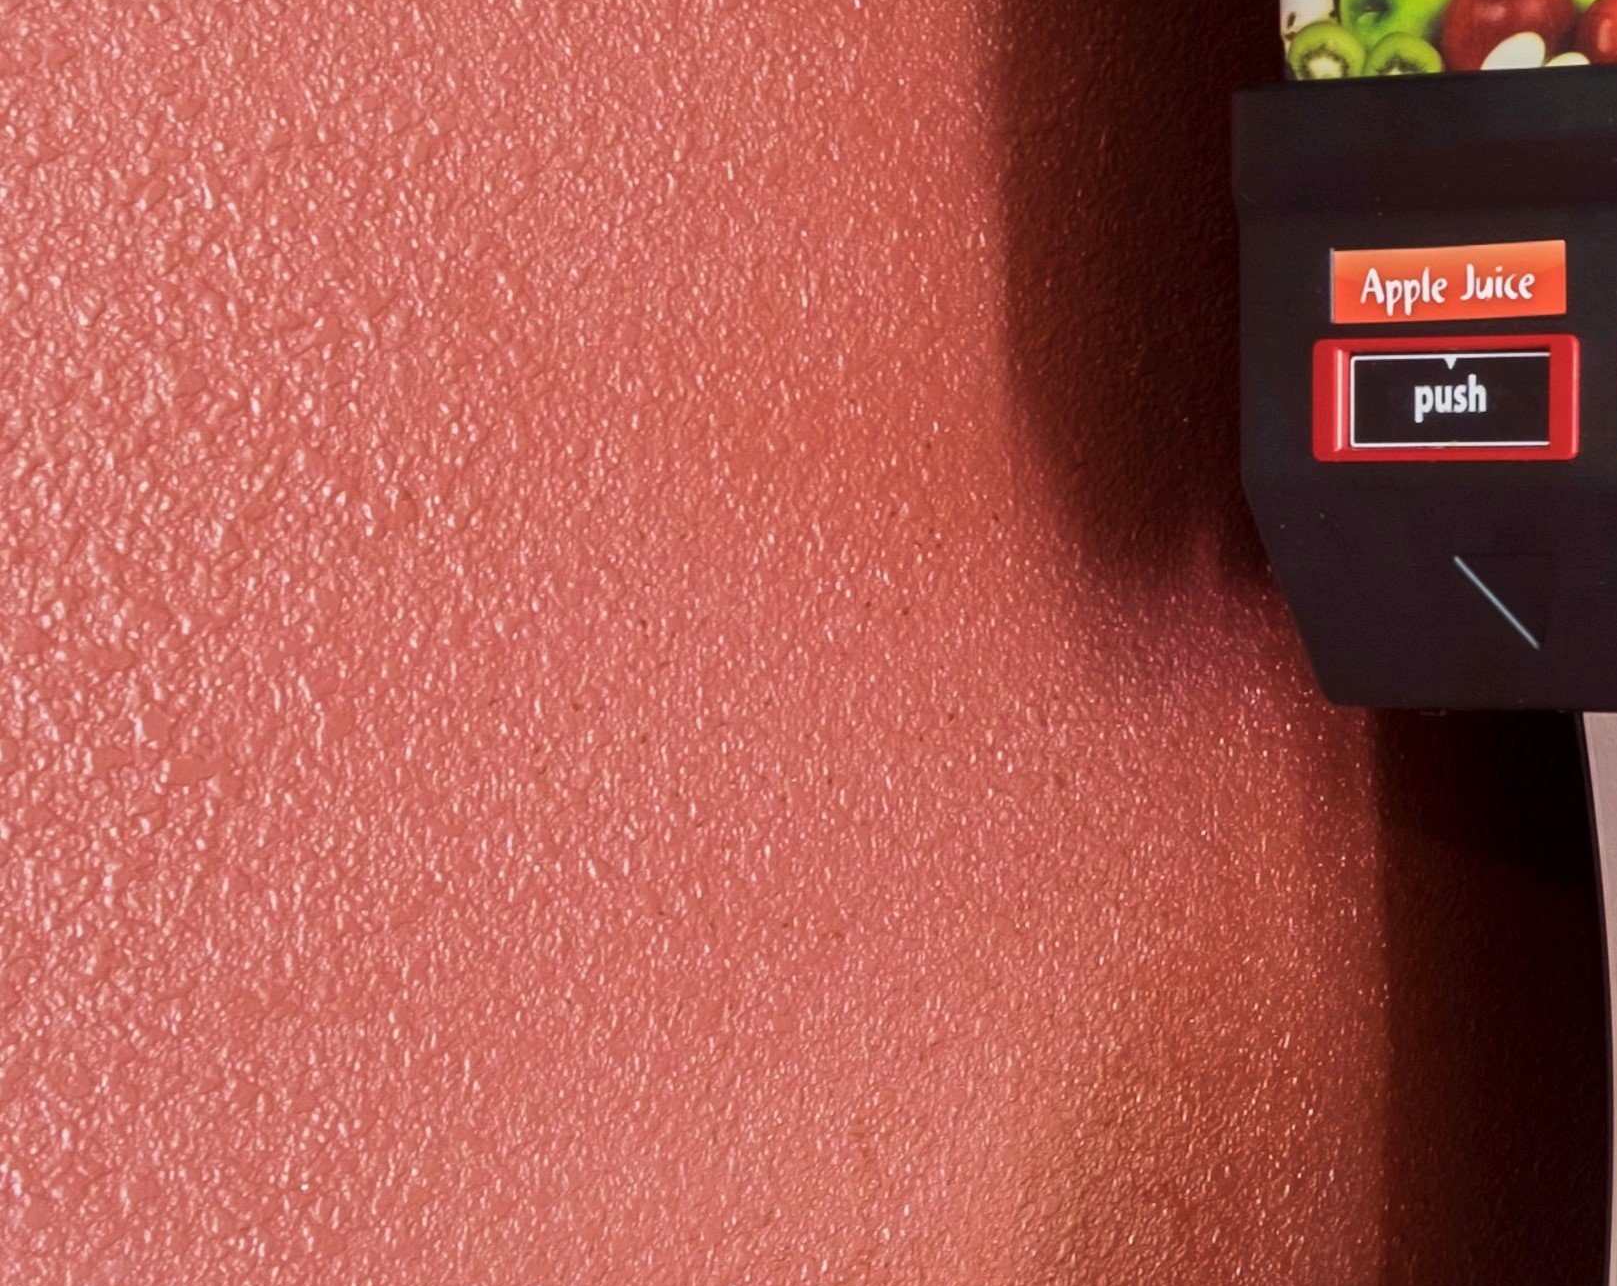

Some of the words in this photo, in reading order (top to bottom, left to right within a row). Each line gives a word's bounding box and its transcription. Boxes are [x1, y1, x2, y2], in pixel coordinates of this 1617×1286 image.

[1360, 267, 1447, 315] Apple
[1460, 264, 1535, 301] Juice
[1414, 374, 1487, 423] push
